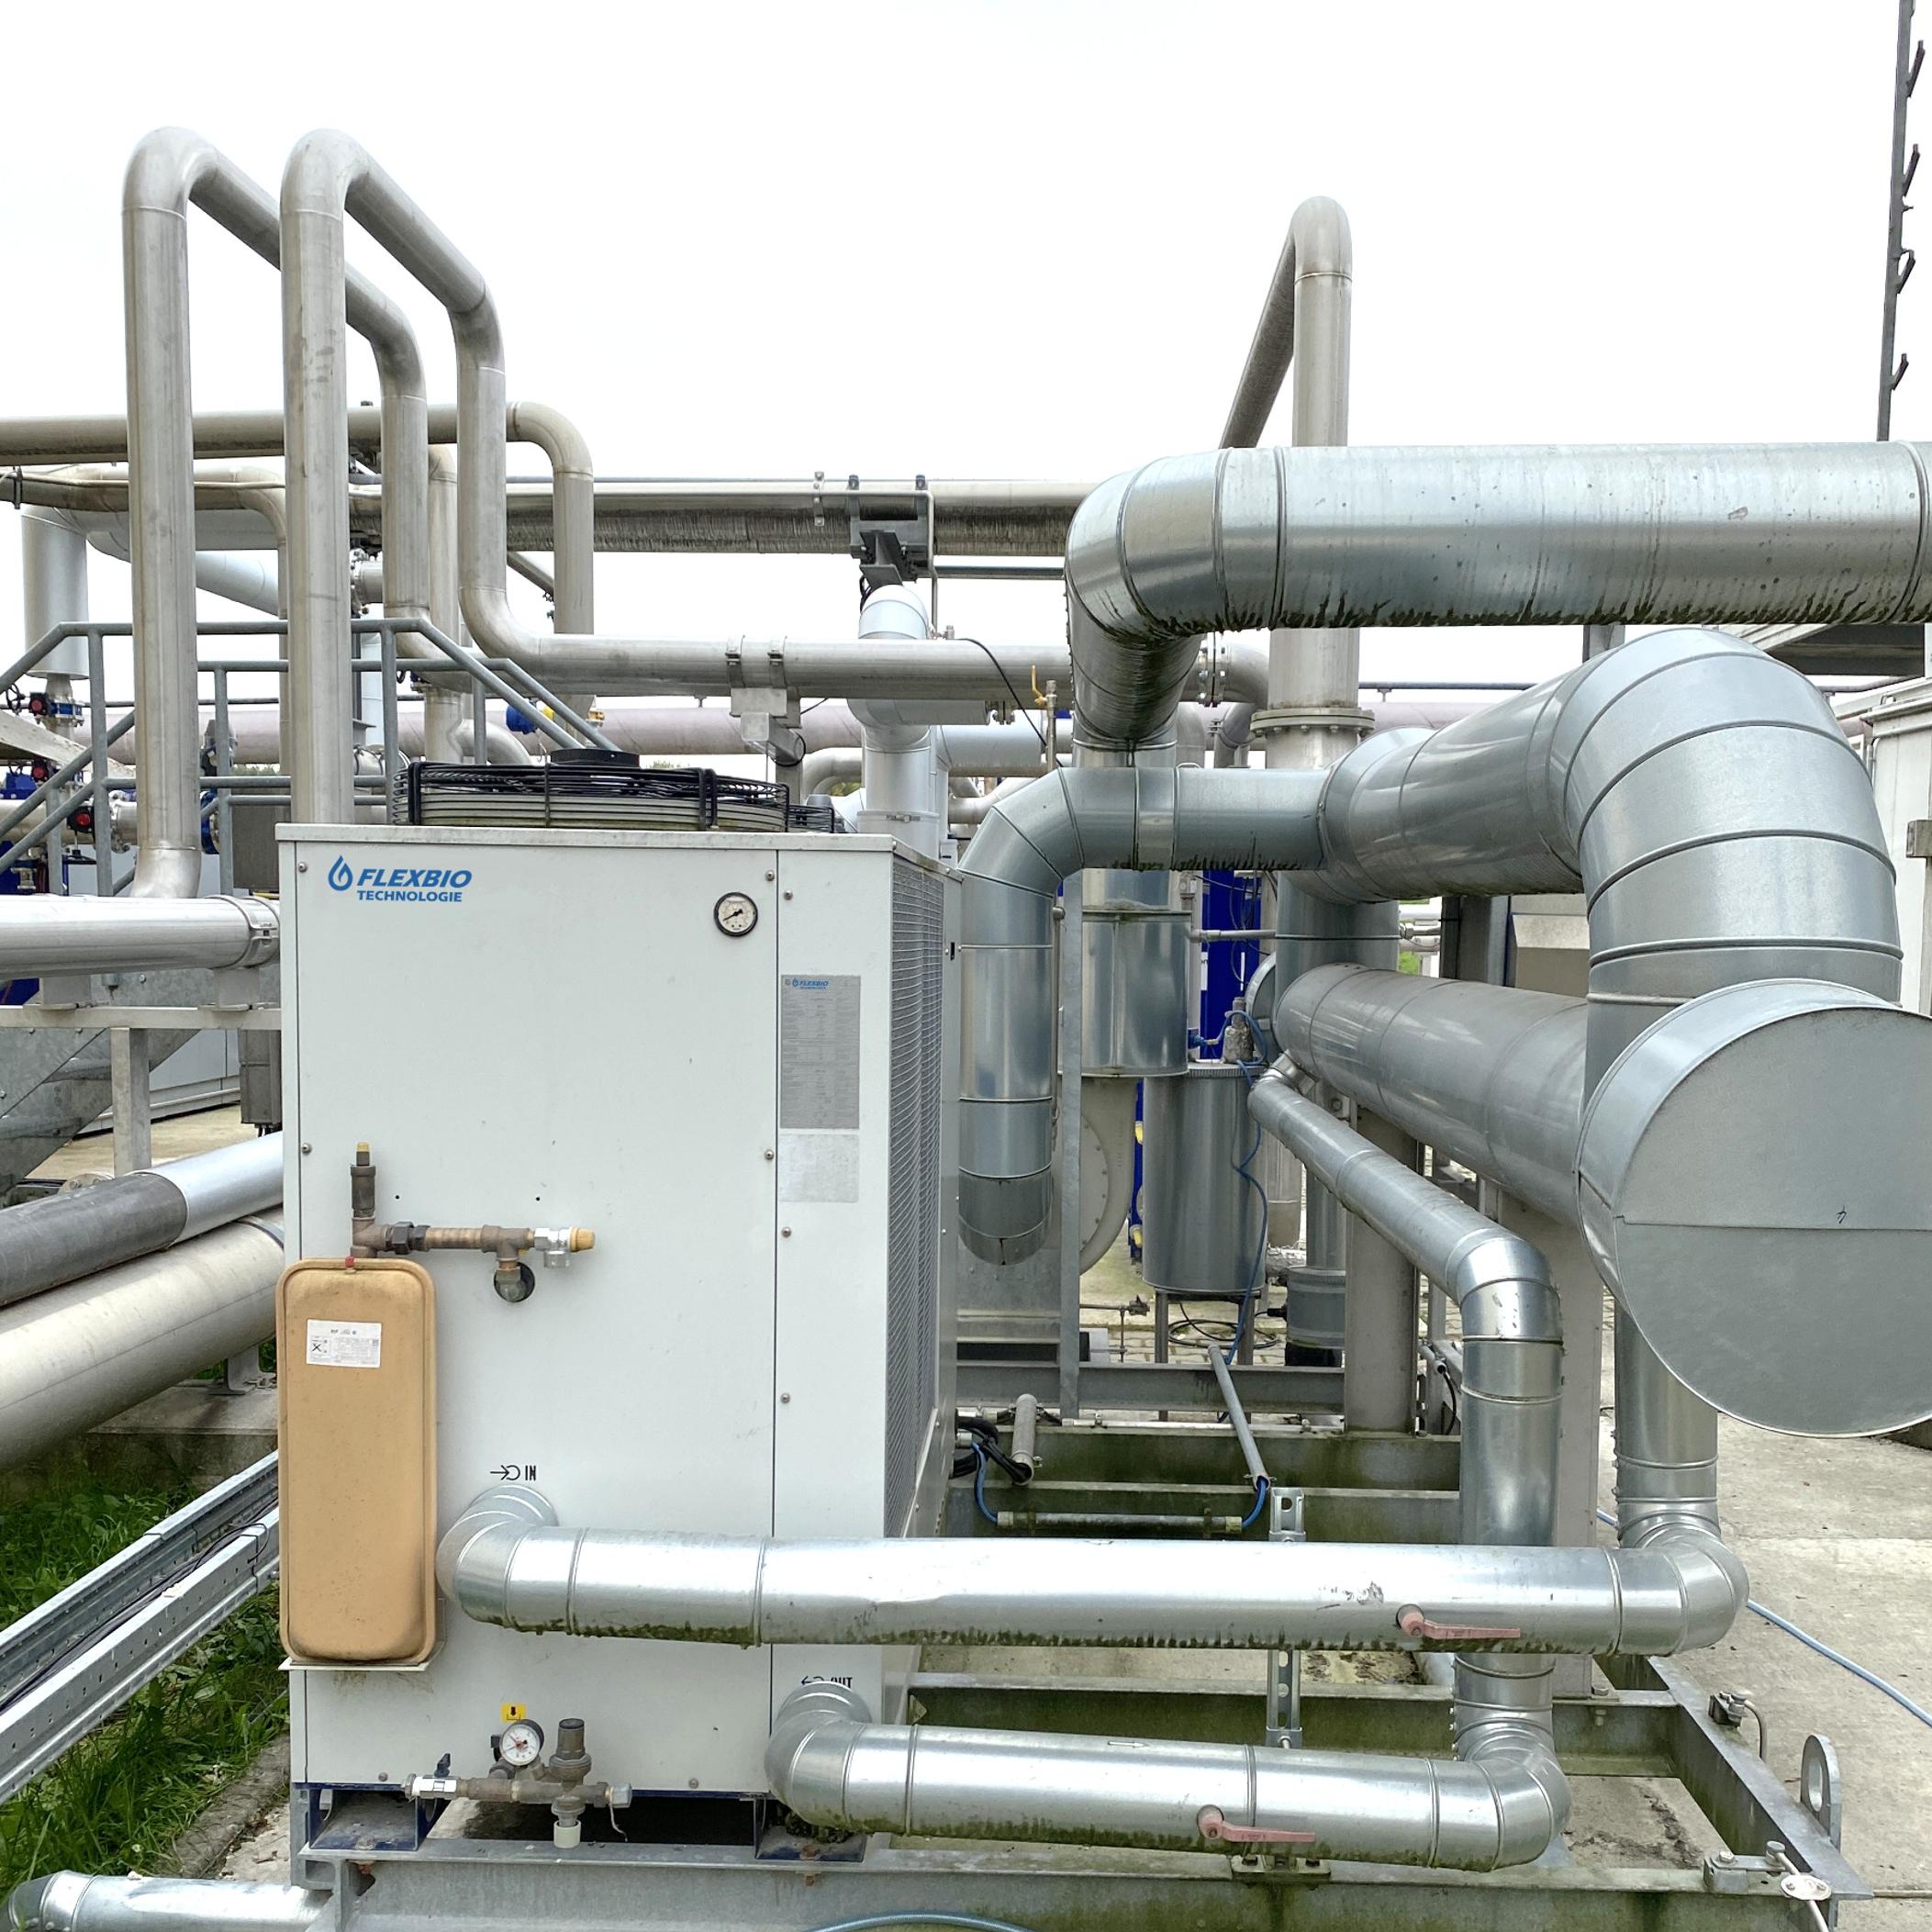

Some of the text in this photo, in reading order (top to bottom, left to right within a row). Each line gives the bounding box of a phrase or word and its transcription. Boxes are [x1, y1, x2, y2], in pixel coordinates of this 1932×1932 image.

[357, 868, 473, 888] FLEXBIO
[357, 890, 463, 902] TECHNOLOGIE
[525, 1465, 537, 1481] IN
